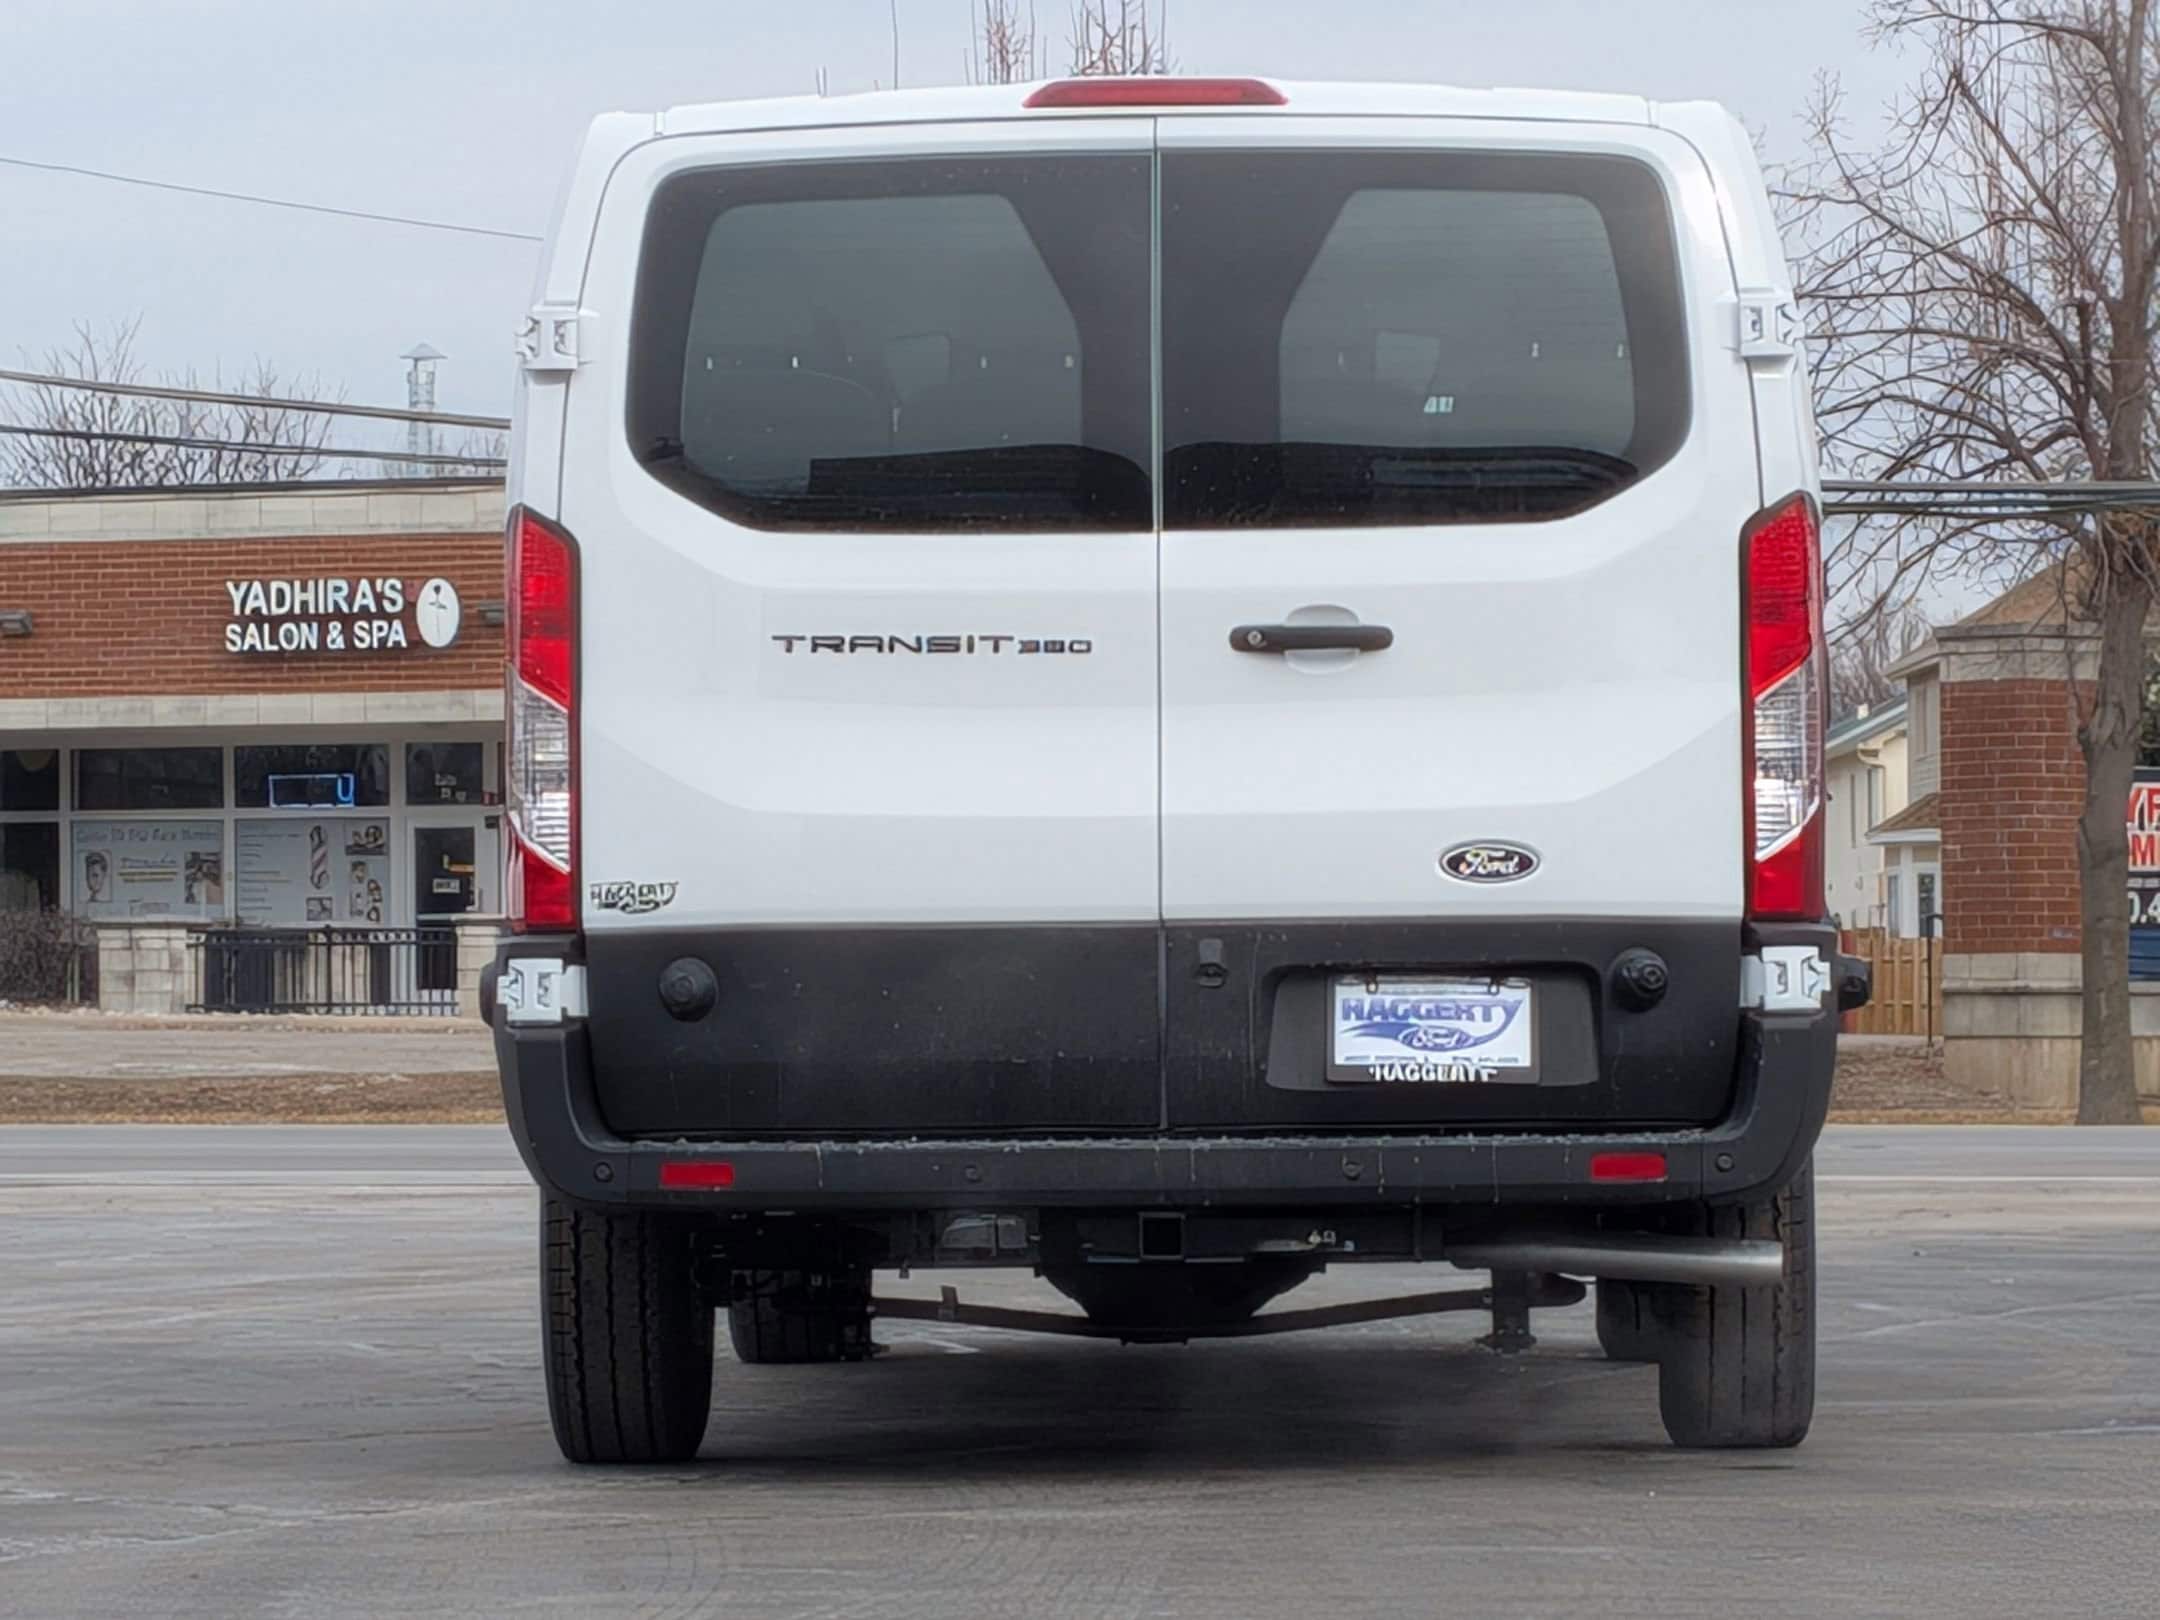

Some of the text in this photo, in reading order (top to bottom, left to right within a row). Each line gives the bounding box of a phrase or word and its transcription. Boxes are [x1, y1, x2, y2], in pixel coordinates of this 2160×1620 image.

[226, 578, 404, 615] YADHIRA'S
[225, 619, 407, 652] SALON & SPA
[772, 635, 1014, 653] TRANSIT
[1458, 848, 1520, 875] Ford
[1342, 998, 1523, 1027] HAGGERTY
